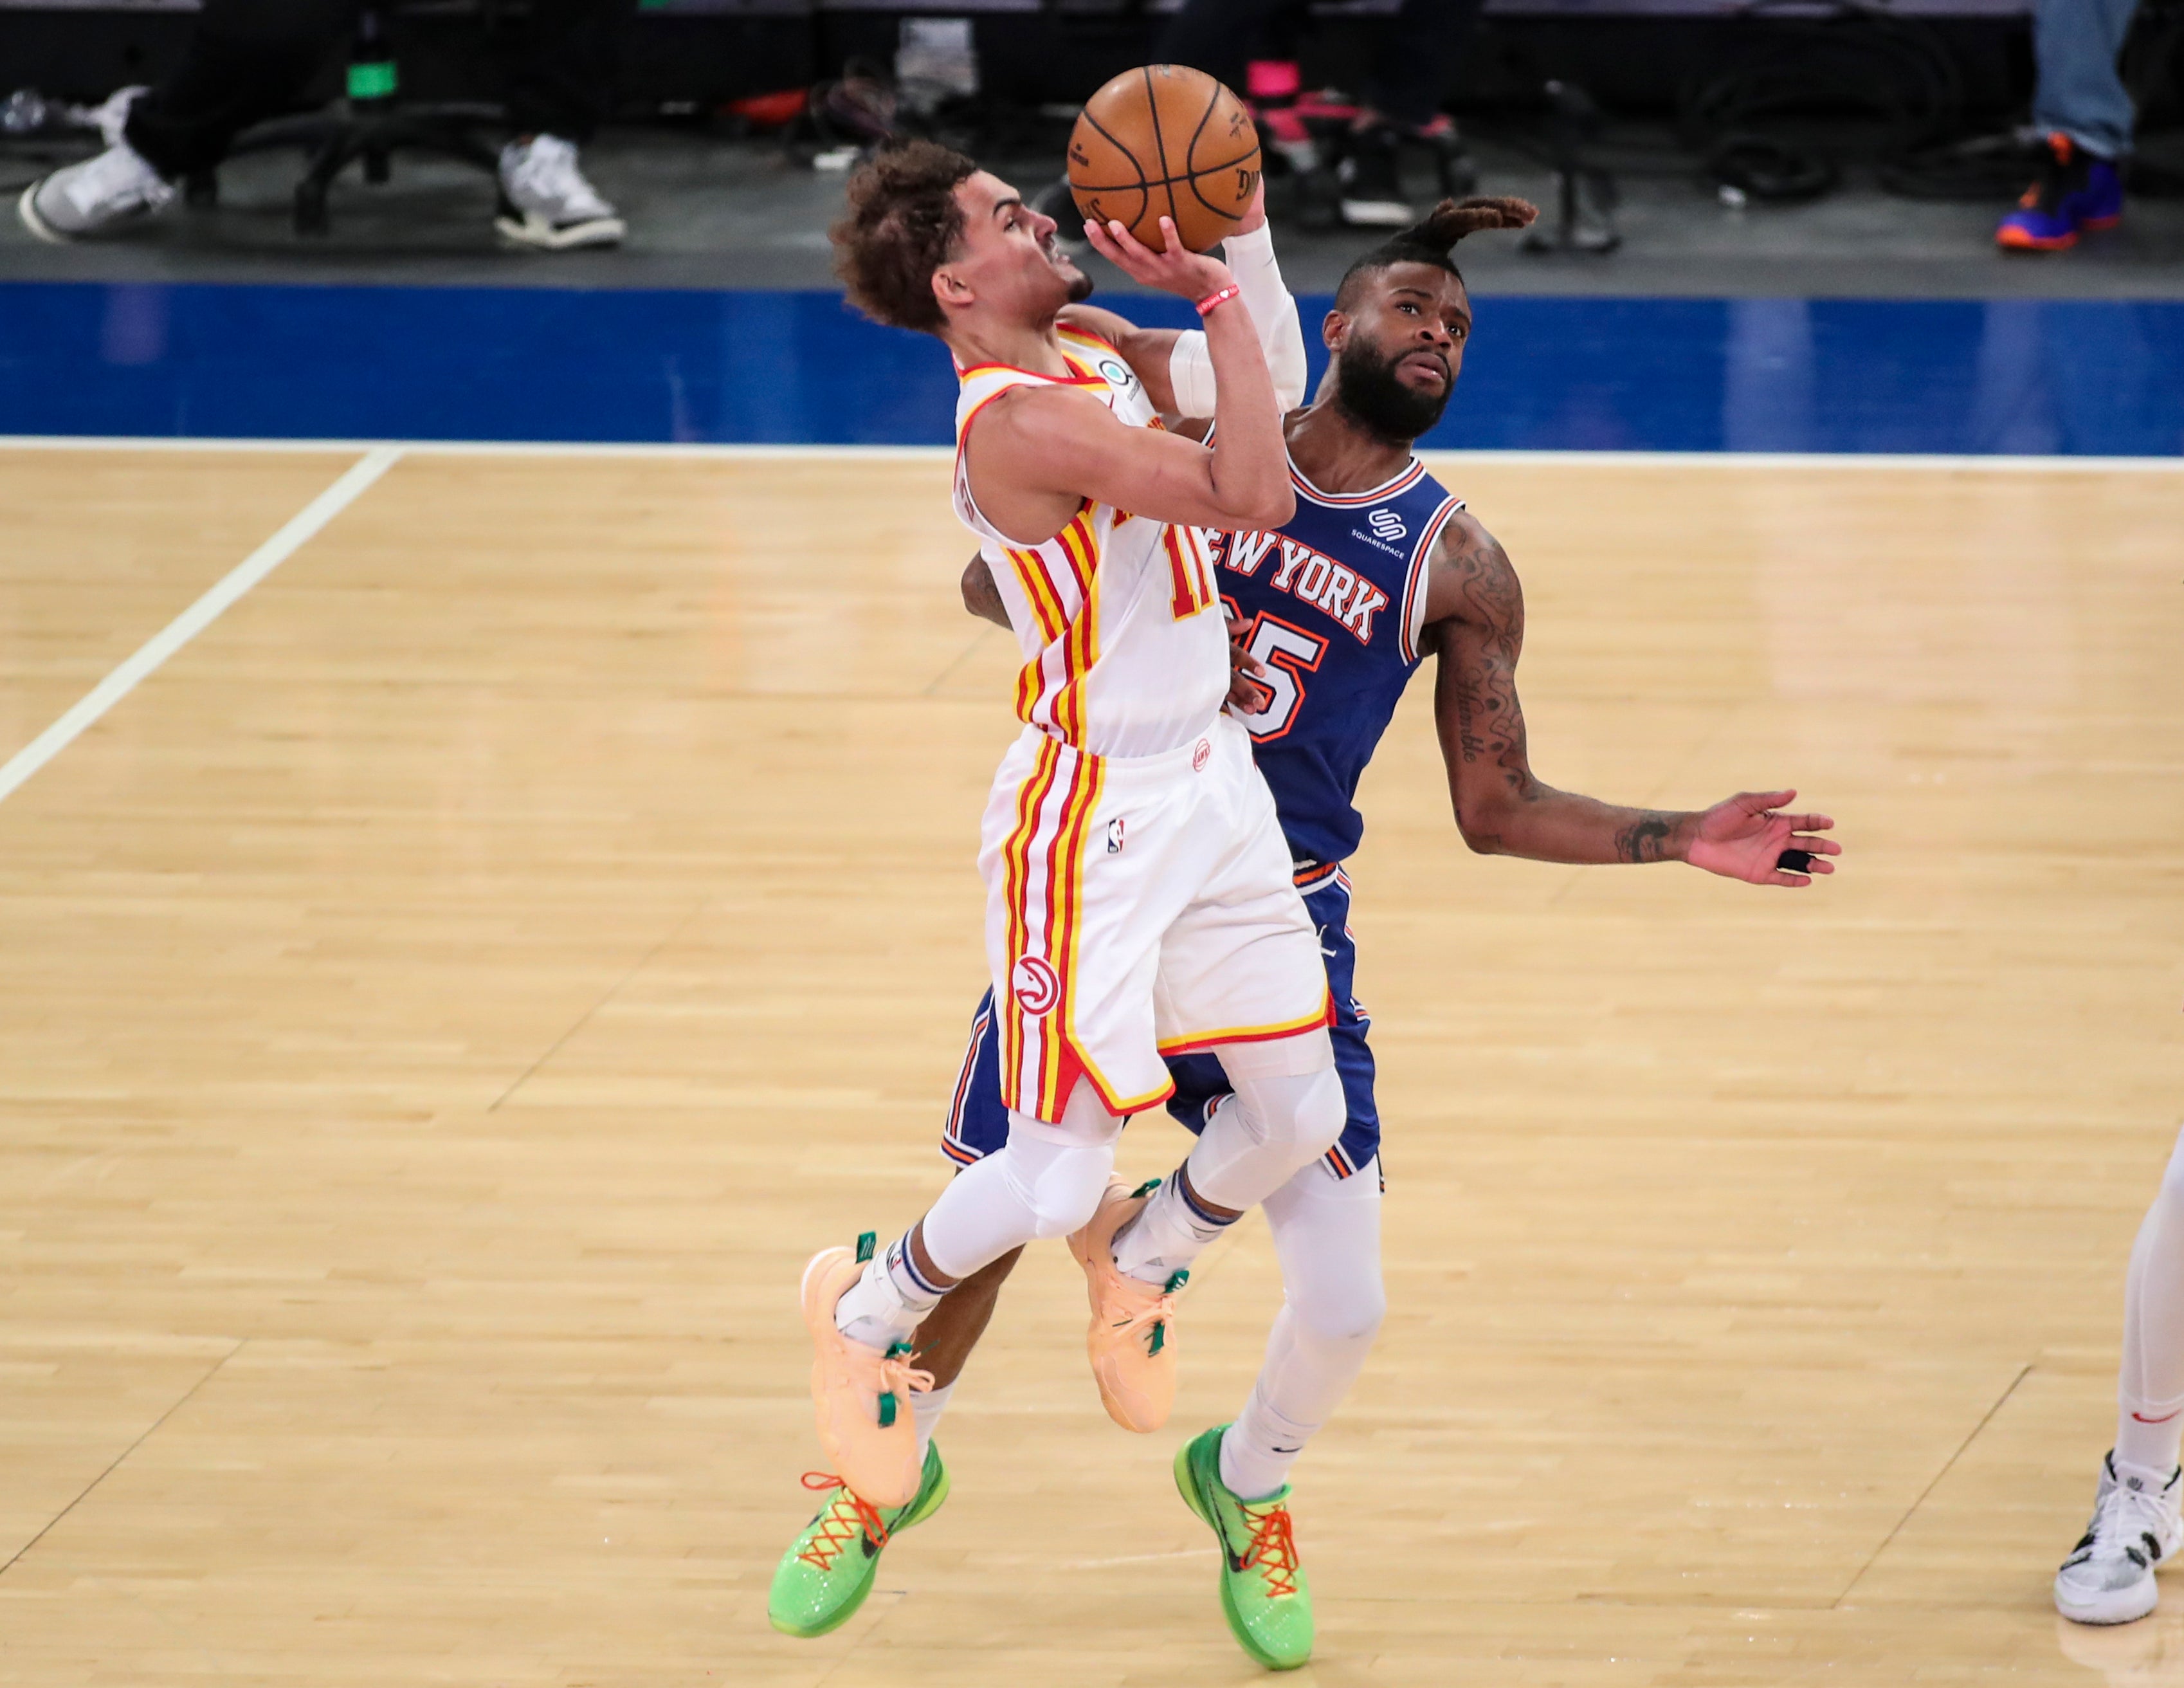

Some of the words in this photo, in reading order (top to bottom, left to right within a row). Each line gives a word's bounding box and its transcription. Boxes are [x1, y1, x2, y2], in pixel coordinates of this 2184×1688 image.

[1201, 528, 1282, 577] EW
[1269, 535, 1389, 646] YORK
[1351, 529, 1405, 560] SQUARESPACE
[1219, 593, 1330, 744] 5
